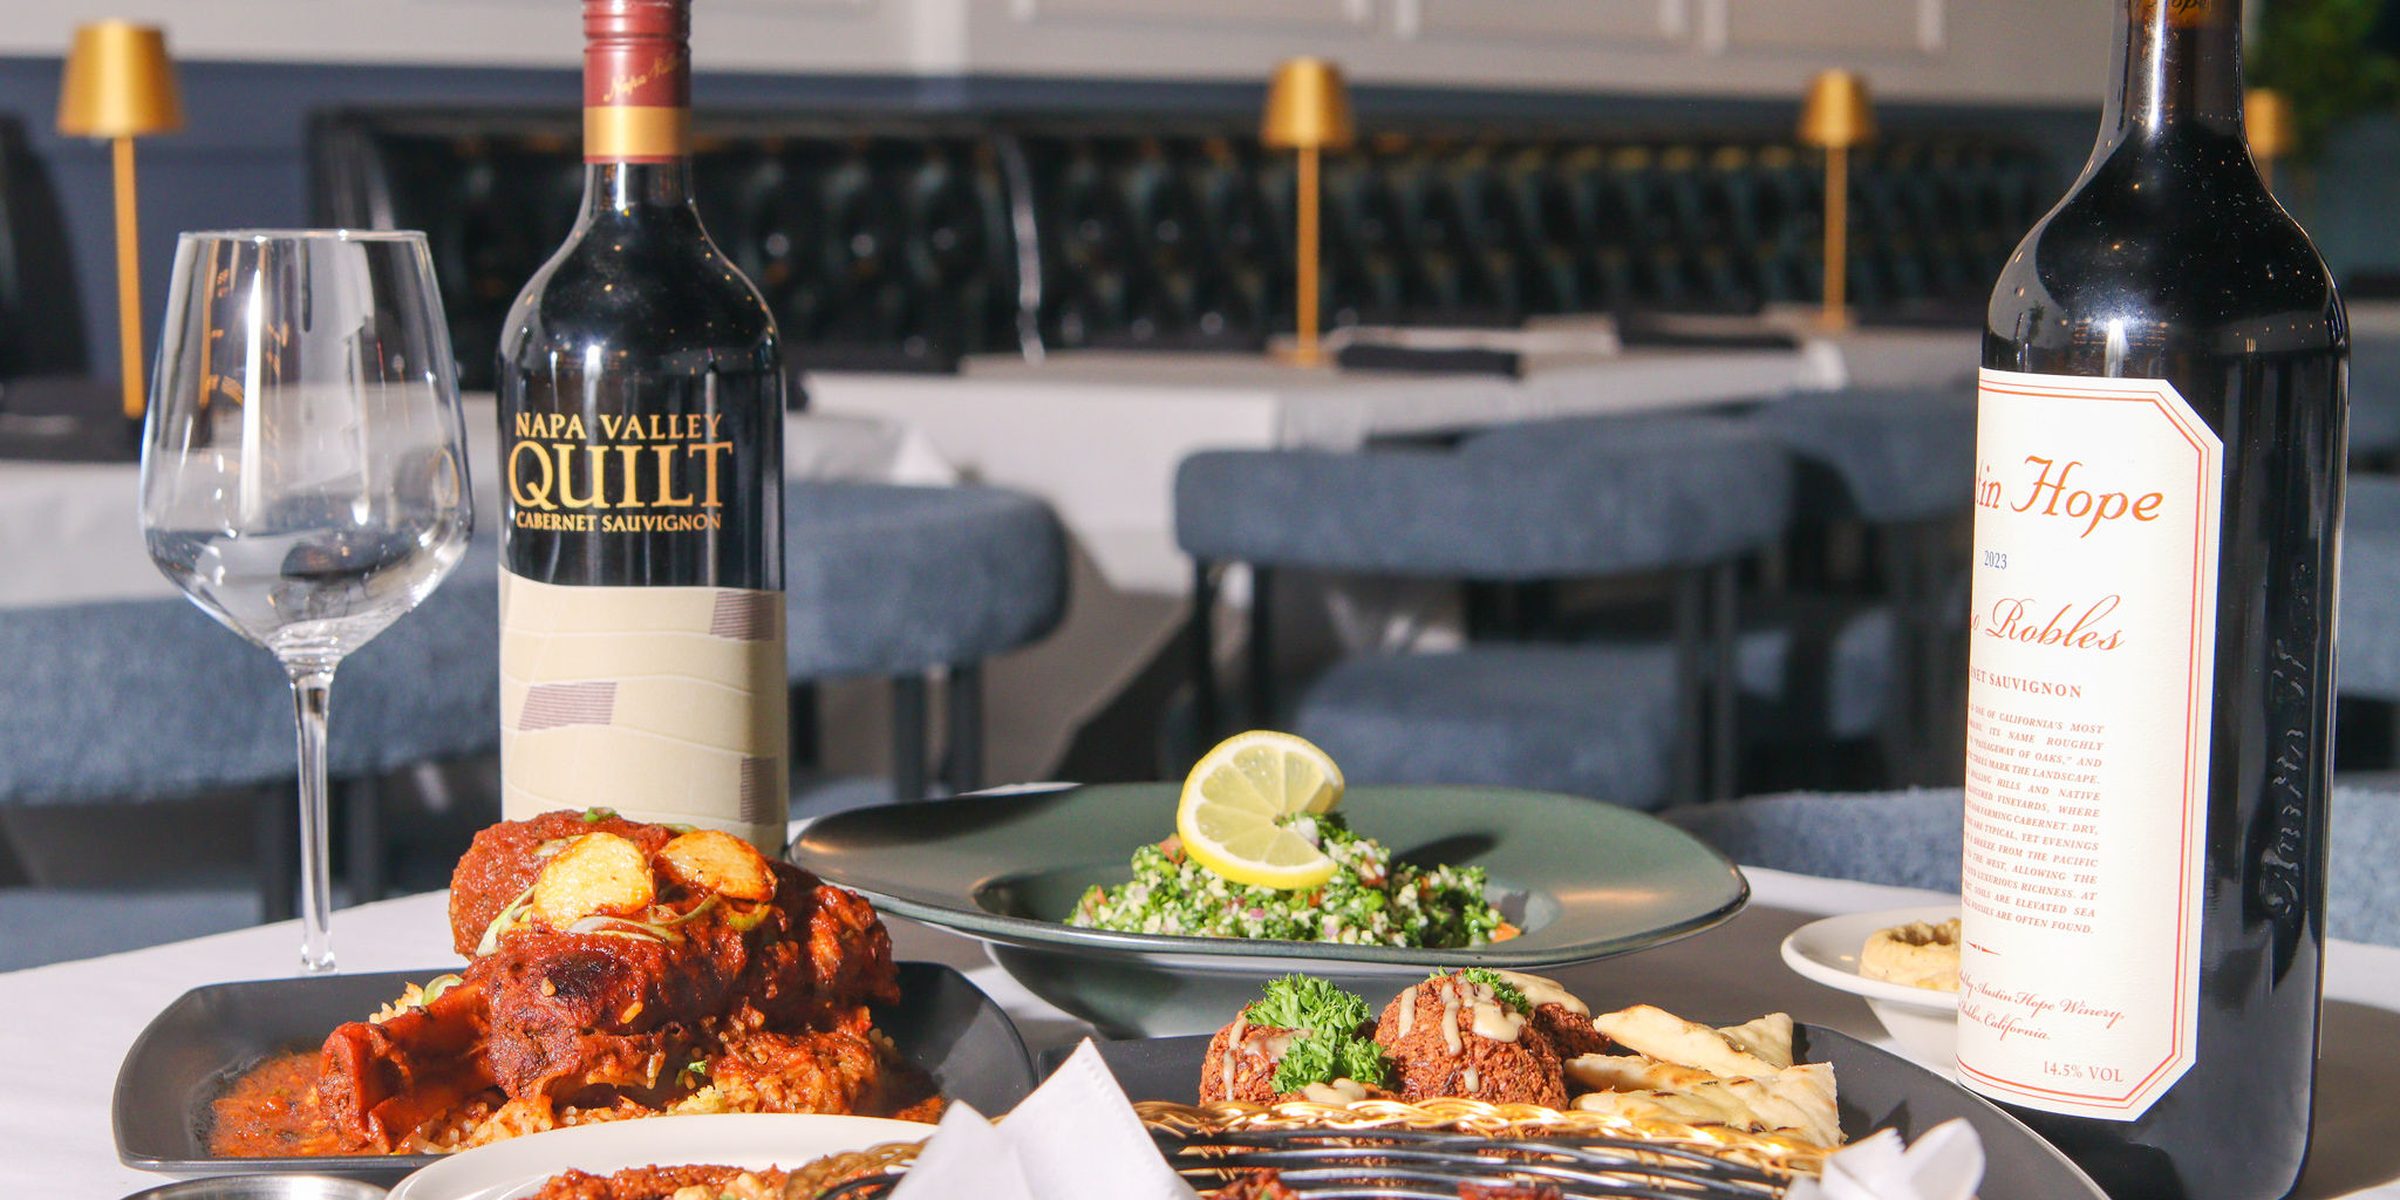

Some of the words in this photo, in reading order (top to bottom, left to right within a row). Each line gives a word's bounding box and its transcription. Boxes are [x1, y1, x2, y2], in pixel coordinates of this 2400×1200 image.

[515, 412, 587, 440] NAPA
[599, 413, 722, 440] VALLEY
[508, 440, 734, 511] QUILT
[2010, 455, 2164, 539] Hope
[516, 511, 597, 532] CABERNET
[601, 513, 722, 533] SAUVIGNON
[1984, 550, 2007, 570] 2023
[1985, 594, 2125, 650] Robles
[1989, 674, 2081, 698] SAUVIGNON
[1999, 712, 2063, 731] CALIFORNIA'S
[2070, 723, 2104, 734] MOST
[2008, 732, 2035, 743] NAME
[2046, 737, 2104, 751] ROUGHLY
[2018, 750, 2031, 759] OF
[2077, 757, 2102, 768] AND
[2012, 765, 2031, 776] THE
[2032, 768, 2100, 784] LANDSCAPE.
[1996, 778, 2021, 790] HILLS
[2028, 785, 2049, 795] AND
[2058, 788, 2101, 801] NATIVE
[1997, 795, 2050, 813] VINEYARDS,
[2058, 805, 2101, 818] WHERE
[2021, 833, 2039, 844] YET
[2042, 836, 2099, 851] EVENINGS
[1998, 844, 2023, 857] FROM
[2027, 851, 2048, 861] THE
[2052, 854, 2098, 868] PACIFIC
[2012, 865, 2066, 880] ALLOWING
[2073, 873, 2097, 885] THE
[2020, 882, 2076, 899] RICHNESS.
[2081, 892, 2097, 901] AT
[1994, 893, 2011, 904] ARE
[2015, 897, 2067, 914] ELEVATED
[2073, 907, 2095, 918] SEA
[1995, 910, 2013, 921] ARE
[2015, 914, 2048, 928] OFTEN
[2051, 920, 2094, 934] FOUND.
[1974, 982, 2012, 1003] Austin
[2014, 990, 2056, 1018] Hope
[2043, 1060, 2083, 1079] 14.5%
[2088, 1067, 2125, 1083] VOL
